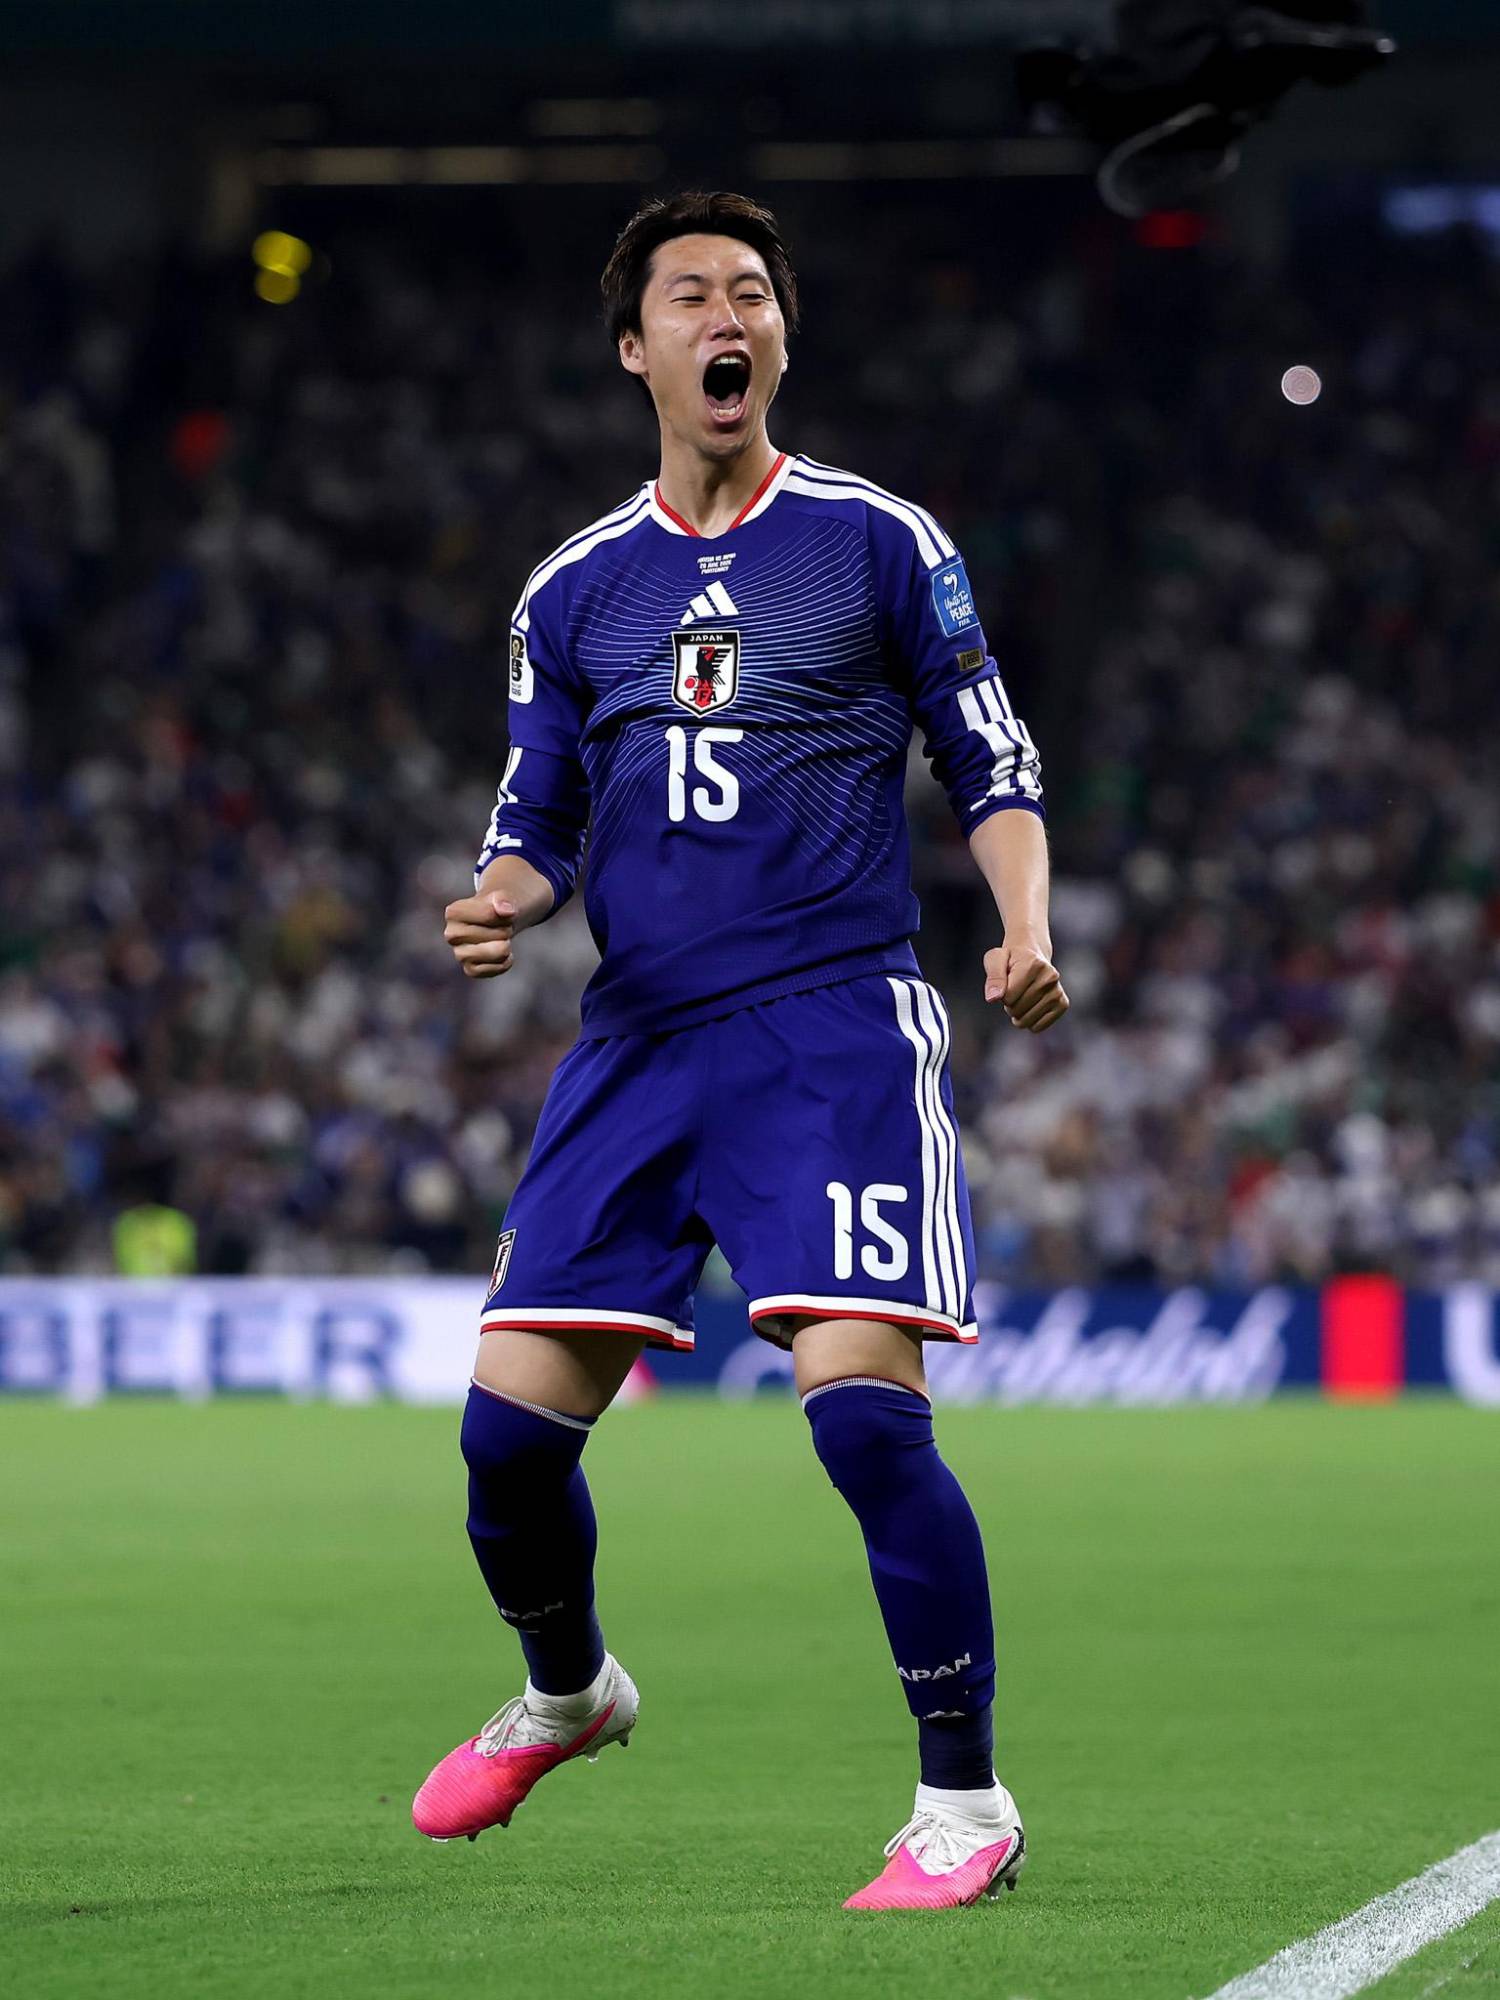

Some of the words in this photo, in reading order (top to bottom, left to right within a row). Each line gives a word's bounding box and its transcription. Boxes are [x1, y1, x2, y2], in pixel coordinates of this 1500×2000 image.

[949, 602, 974, 622] PEACE
[690, 634, 723, 642] JAPAN
[688, 690, 717, 702] JFA
[665, 725, 743, 822] 15
[826, 1182, 908, 1281] 15
[898, 1652, 971, 1681] APAN
